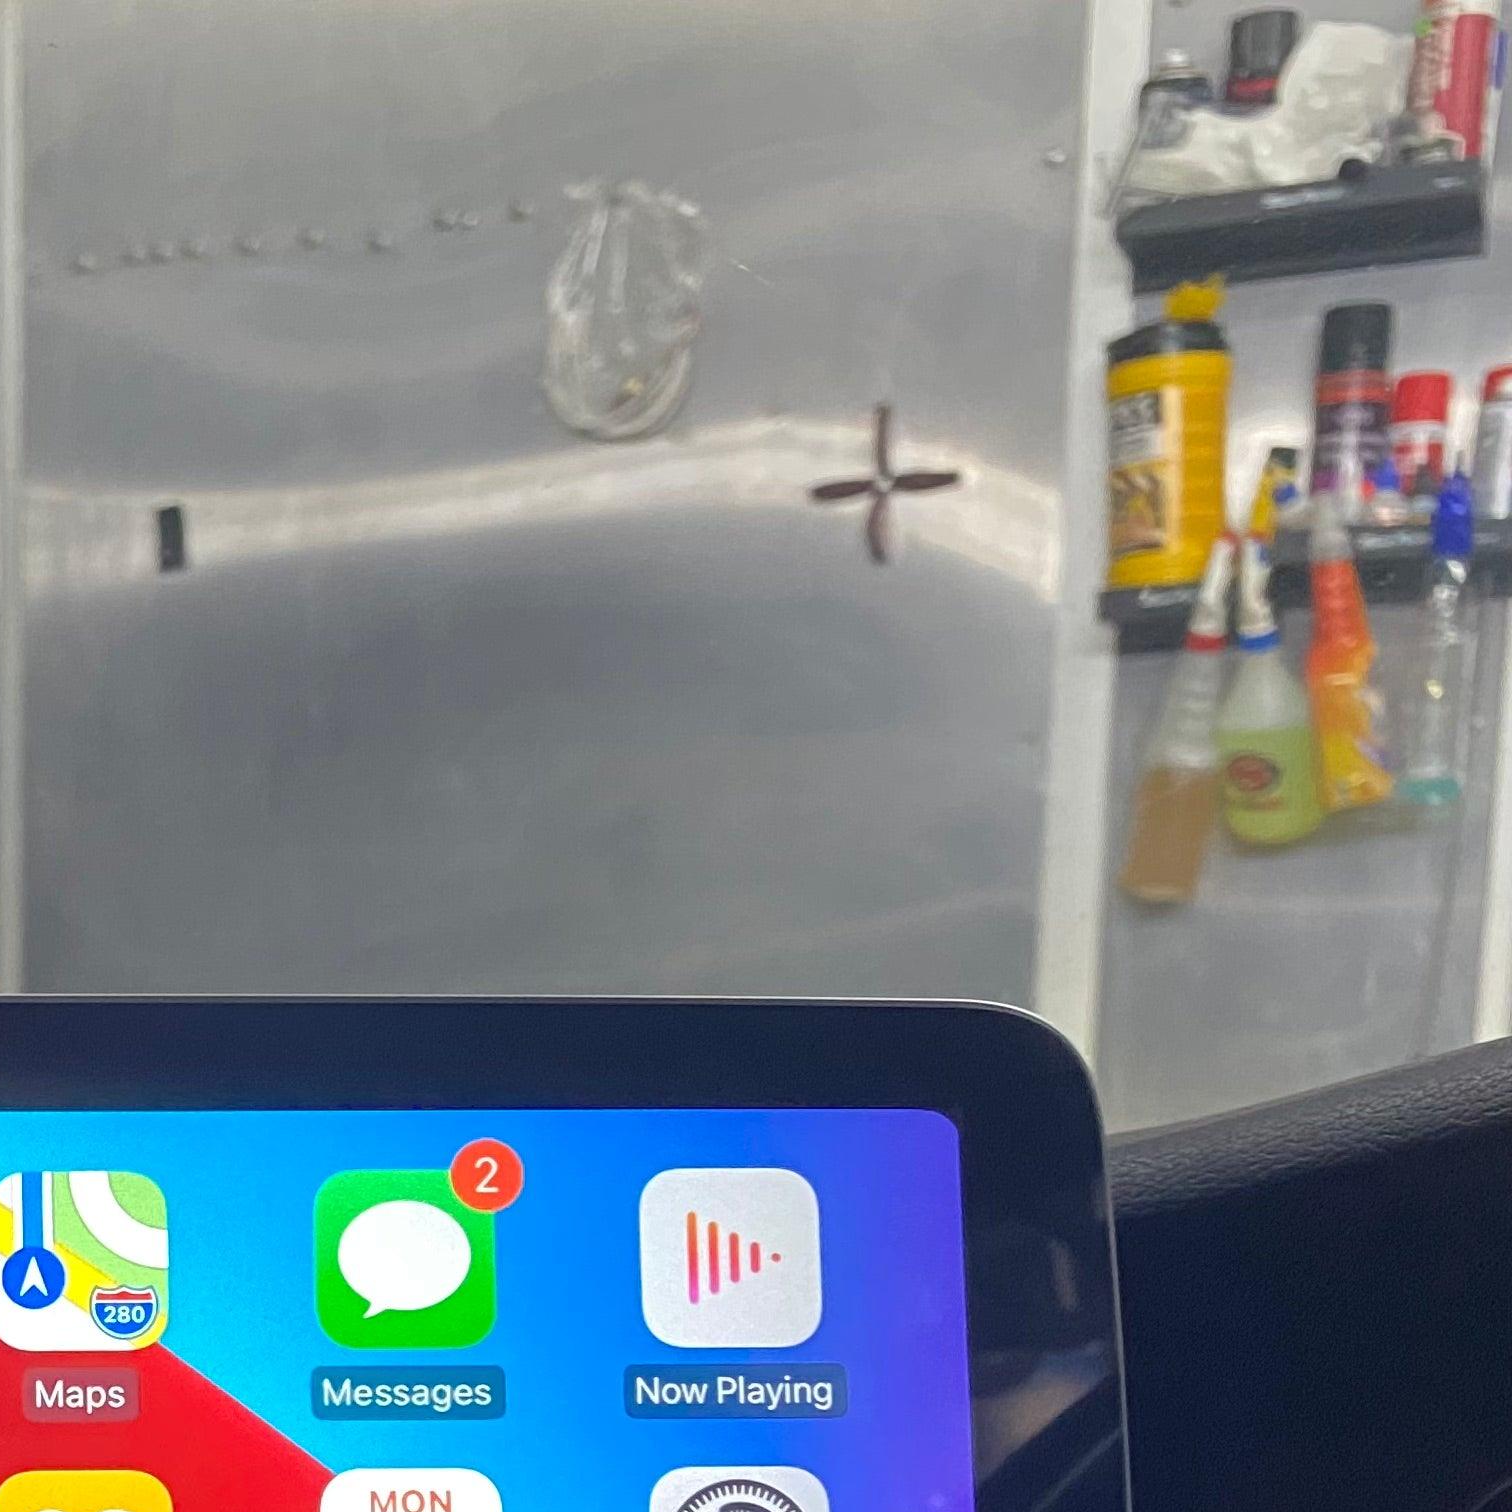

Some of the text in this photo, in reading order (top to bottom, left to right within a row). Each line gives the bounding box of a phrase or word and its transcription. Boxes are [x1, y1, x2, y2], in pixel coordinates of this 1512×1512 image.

[475, 1156, 499, 1194] 2
[103, 1304, 146, 1325] 280
[36, 1380, 124, 1413] Maps
[324, 1379, 491, 1411] Messages
[637, 1376, 832, 1410] Now Playing
